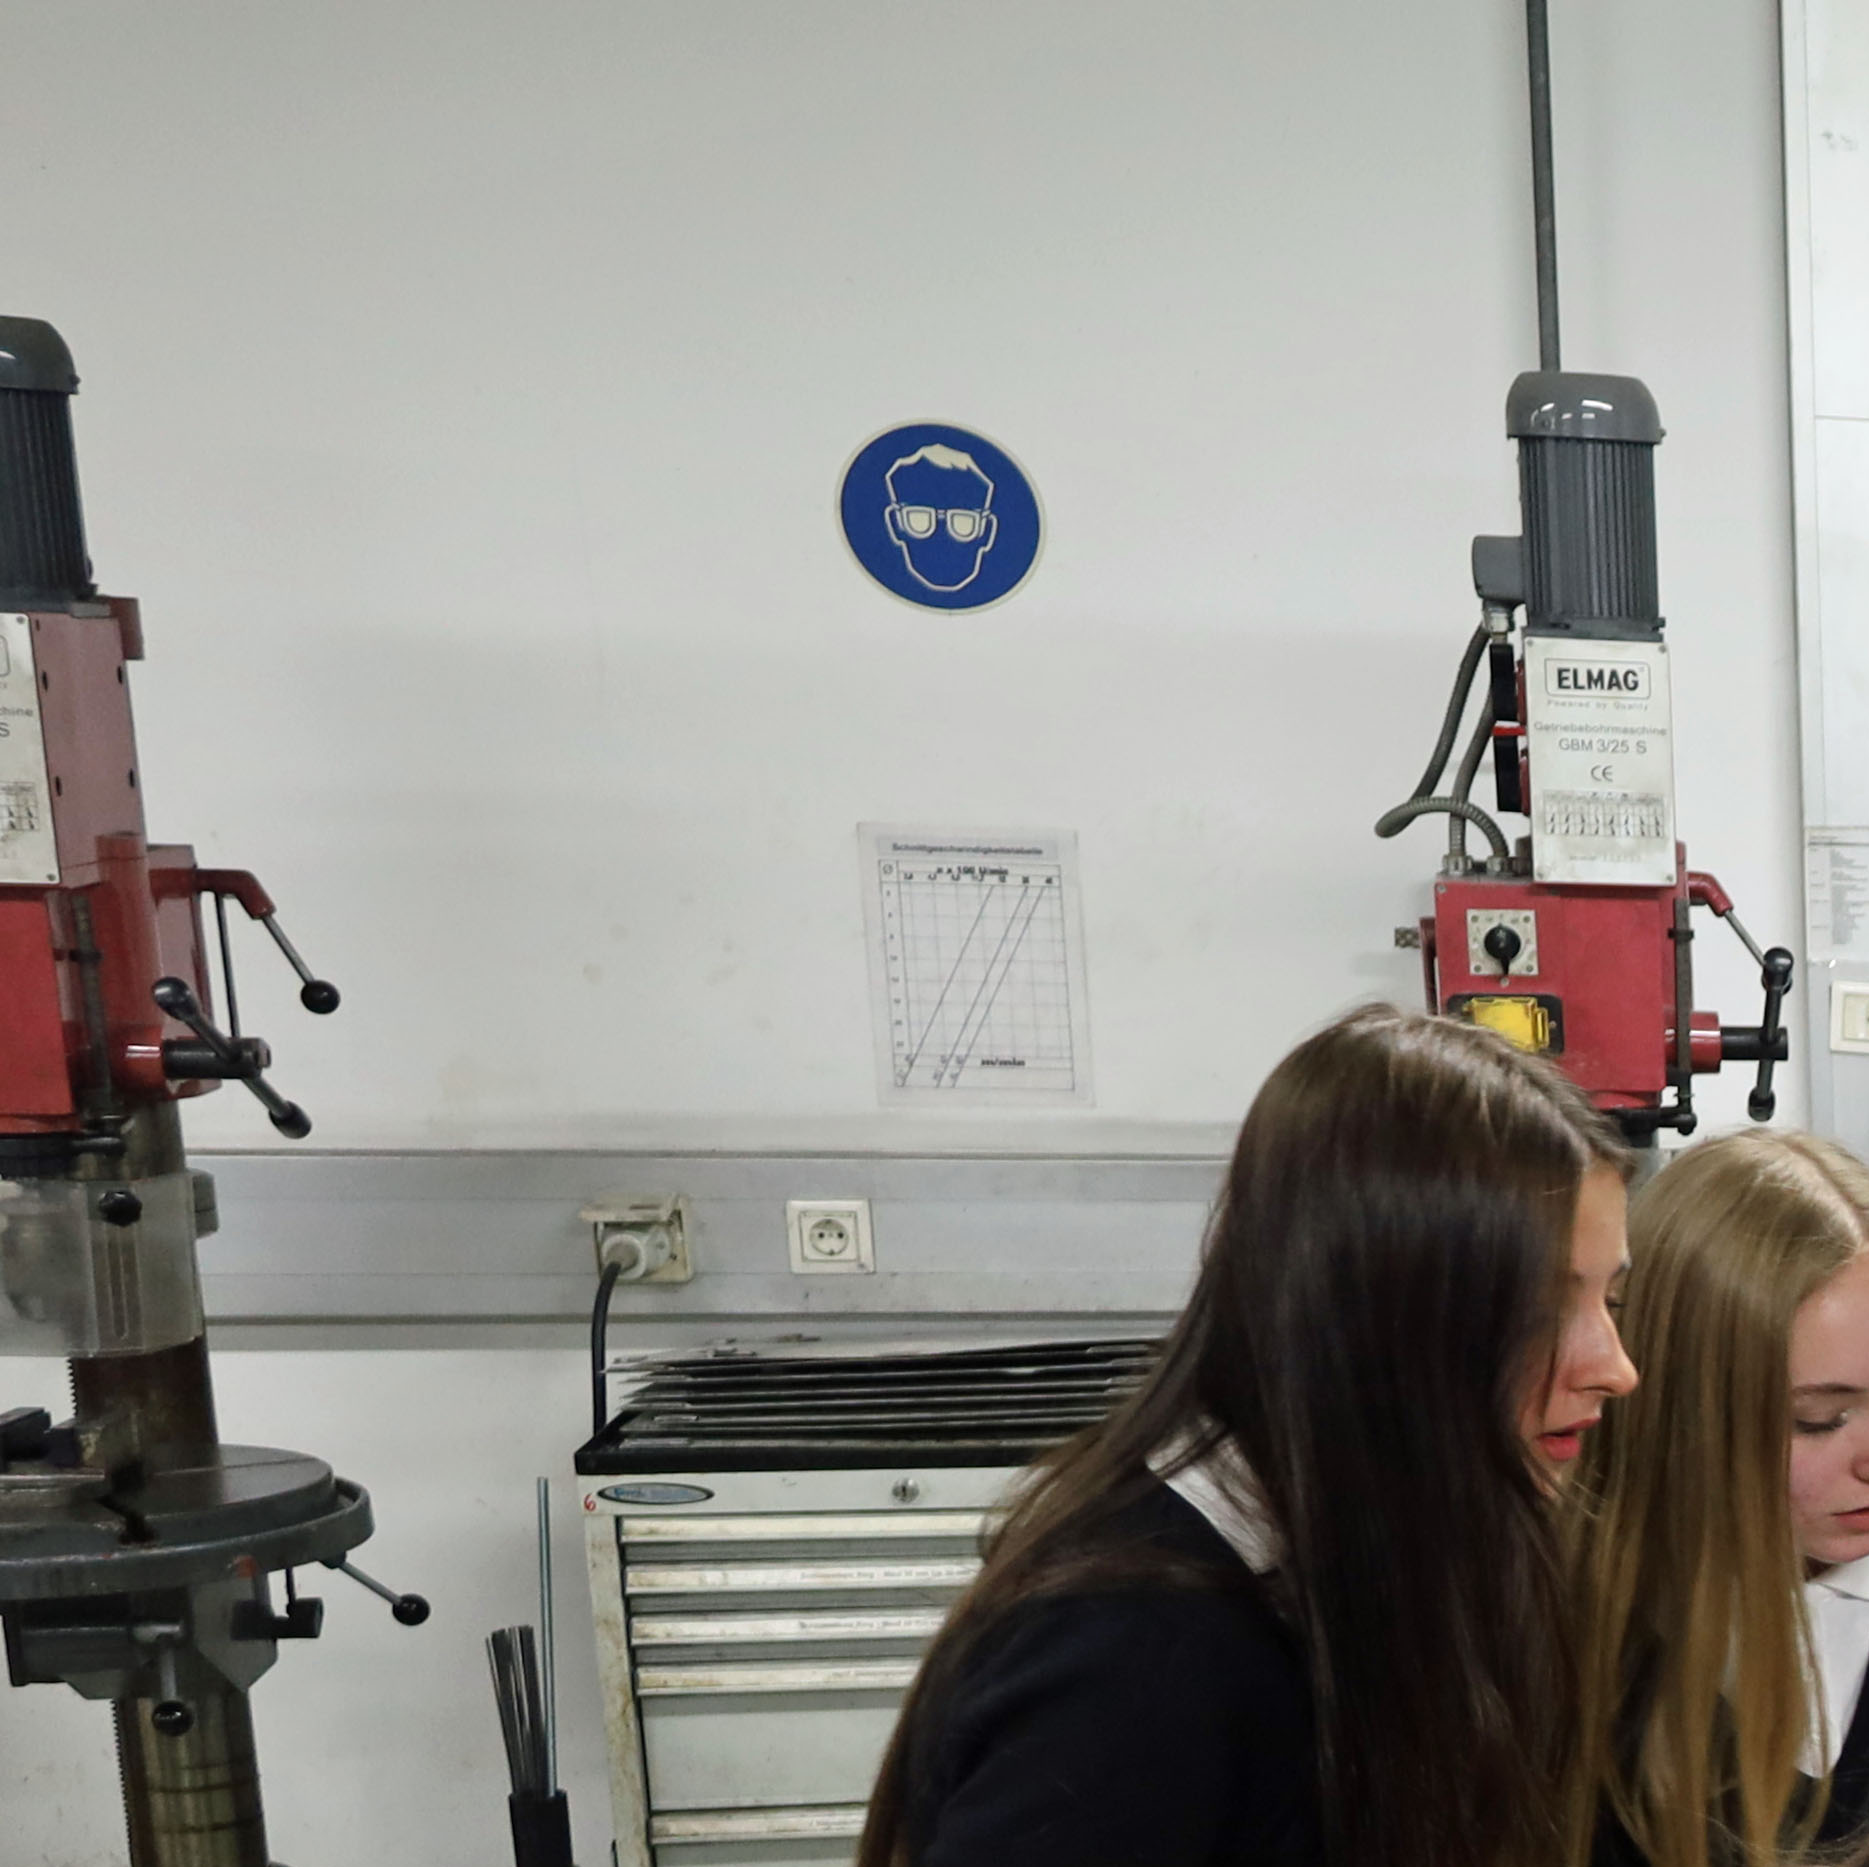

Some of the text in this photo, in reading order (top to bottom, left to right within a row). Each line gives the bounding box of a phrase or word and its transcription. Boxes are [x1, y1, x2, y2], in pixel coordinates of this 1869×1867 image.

[1557, 667, 1639, 692] ELMAG
[1559, 738, 1648, 754] GBM 3/25 S
